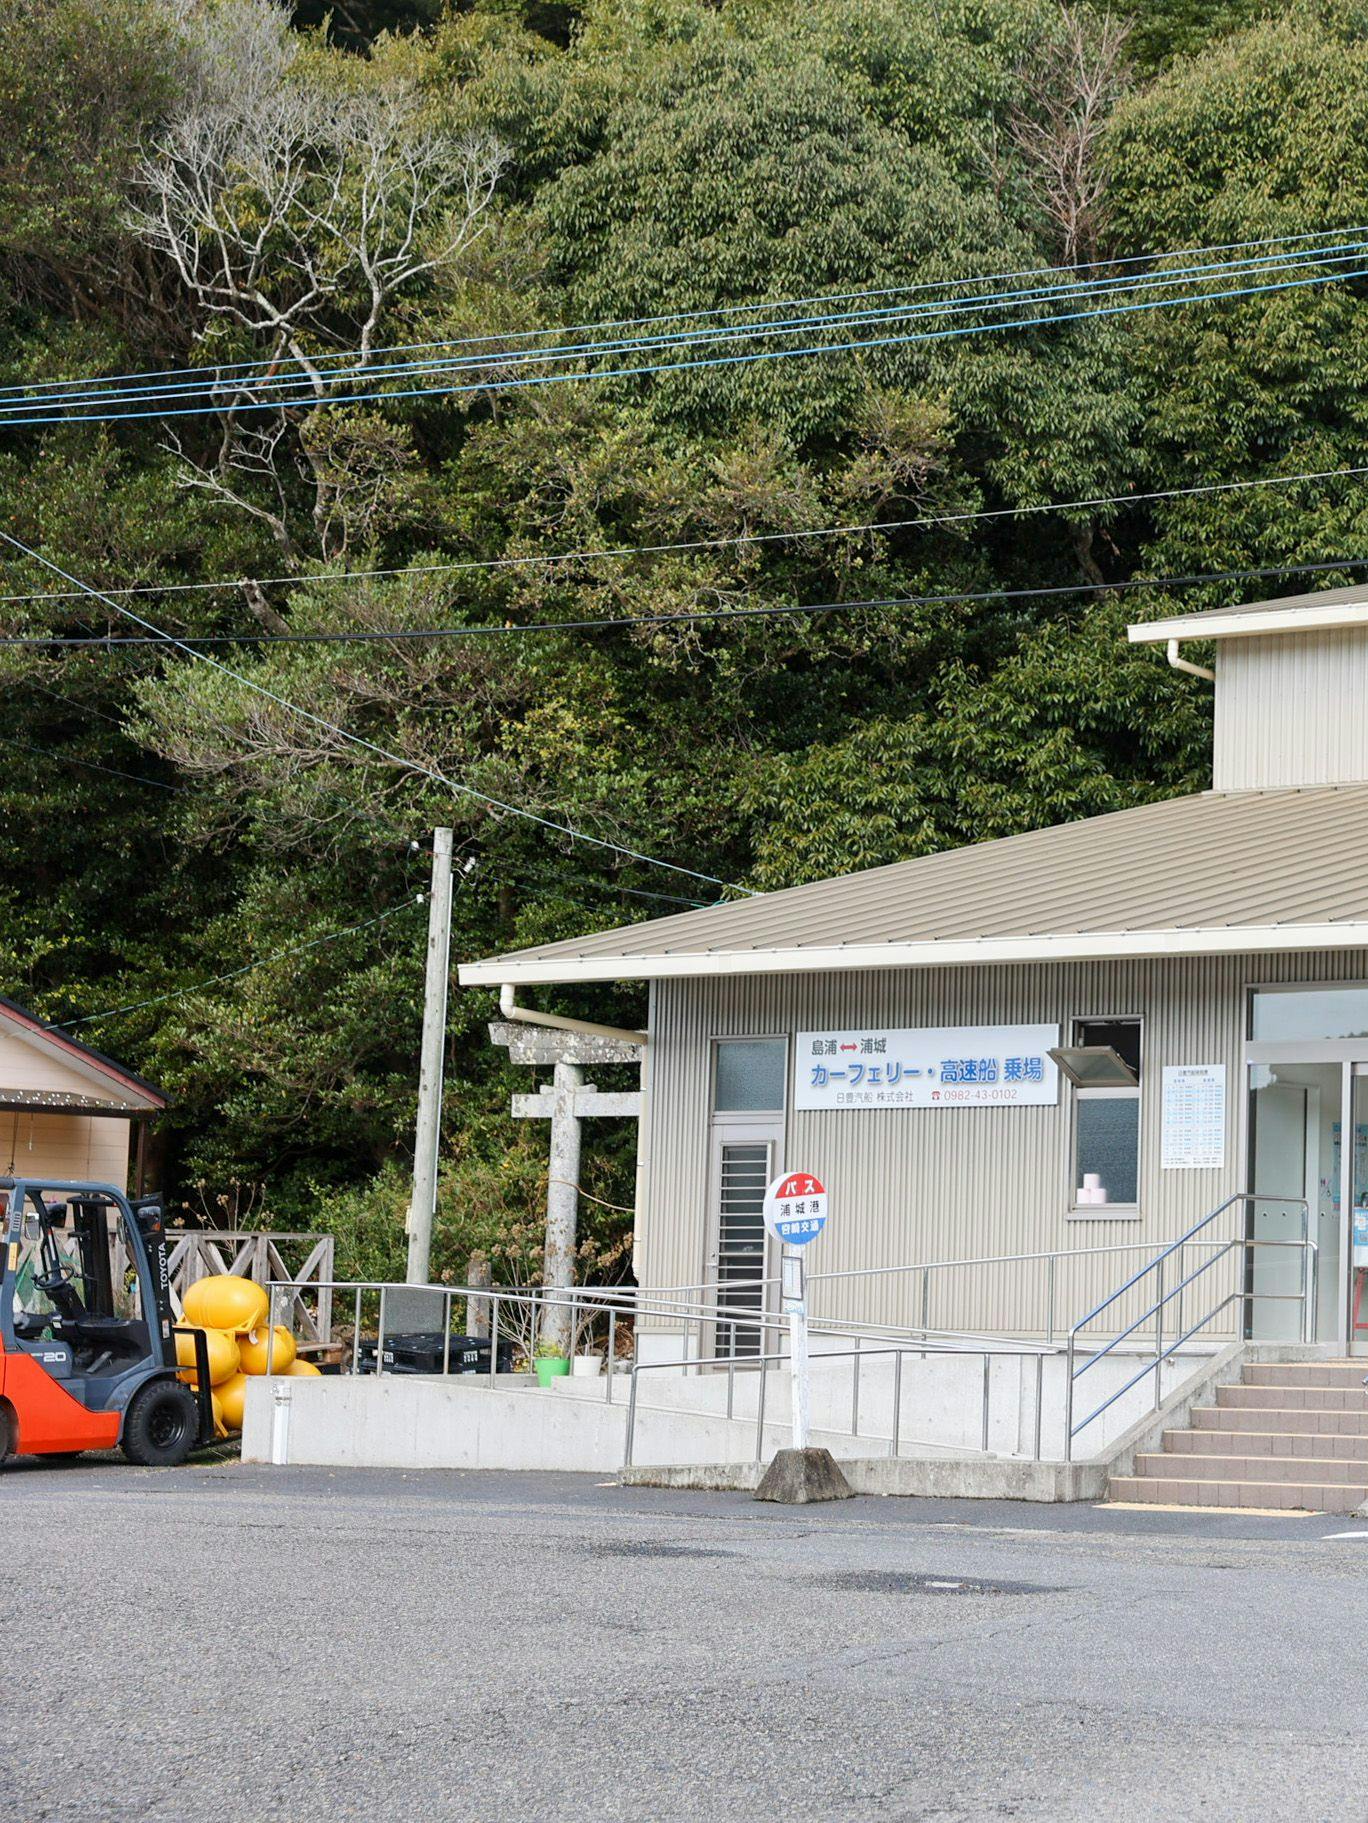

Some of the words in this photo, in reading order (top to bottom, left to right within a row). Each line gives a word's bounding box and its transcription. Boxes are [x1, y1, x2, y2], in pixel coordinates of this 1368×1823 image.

[811, 1040, 837, 1055] 島浦
[860, 1037, 887, 1054] 浦城
[811, 1058, 997, 1085] カーフェリー・高速船
[1004, 1057, 1042, 1081] 乗場
[876, 1090, 914, 1102] 株式会社
[944, 1089, 1017, 1101] 0982-43-0102
[785, 1180, 815, 1195] バス
[158, 1242, 169, 1290] TOYOTA
[43, 1352, 66, 1362] 20
